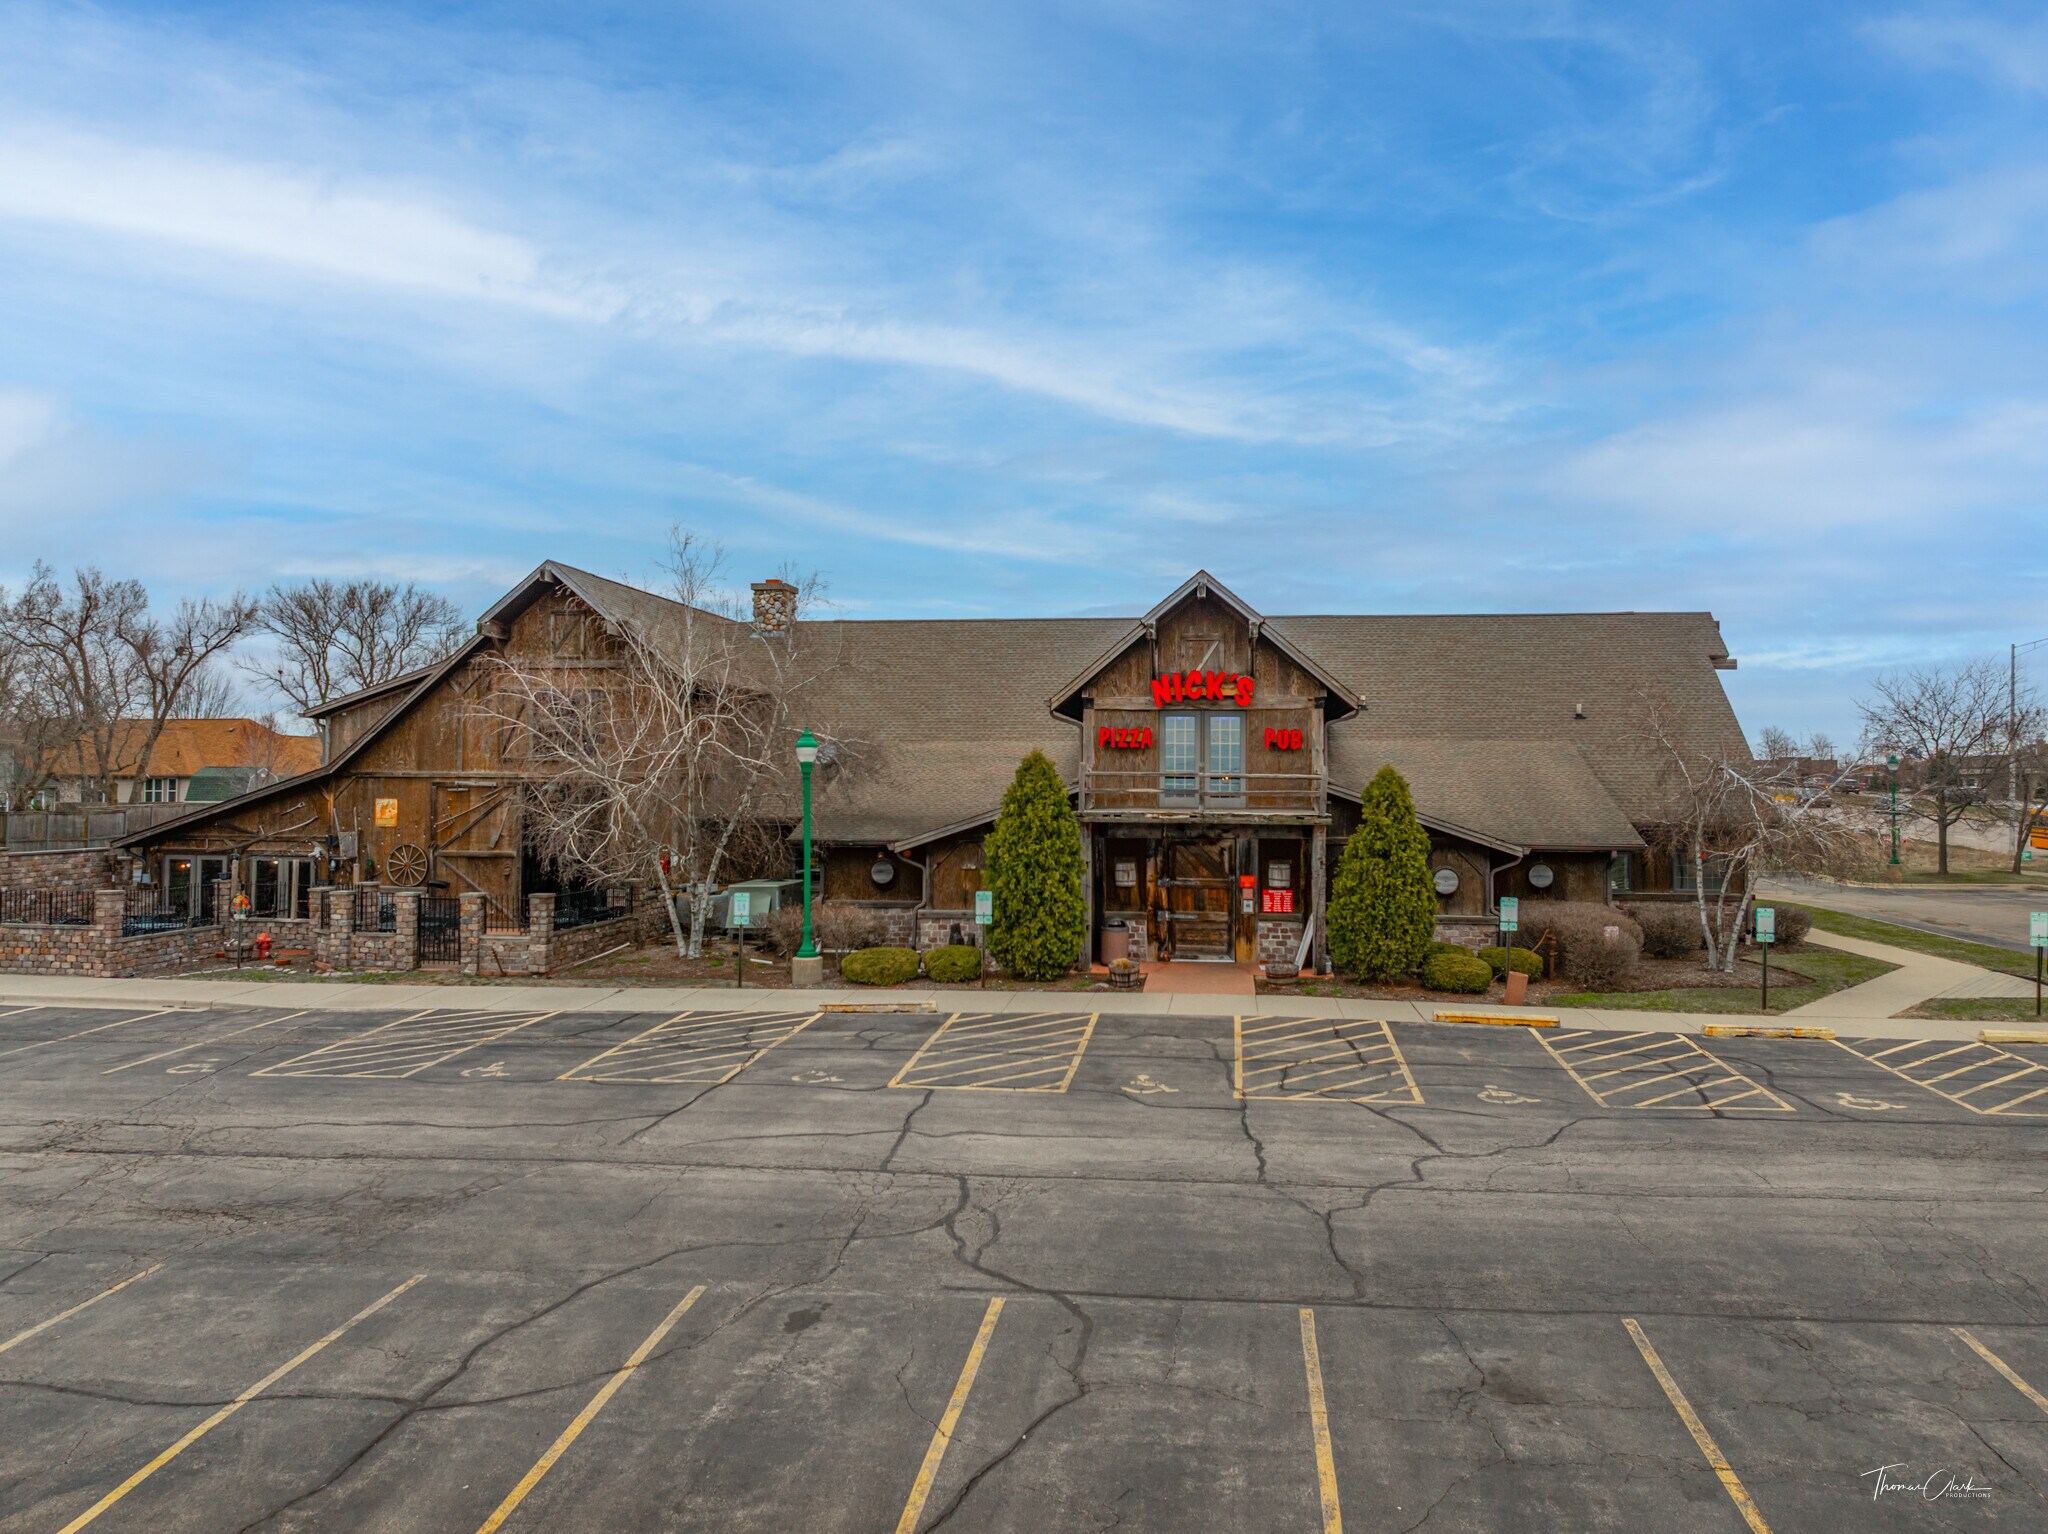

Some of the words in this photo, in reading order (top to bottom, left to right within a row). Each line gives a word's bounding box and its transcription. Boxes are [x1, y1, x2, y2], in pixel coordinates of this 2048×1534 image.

[1151, 669, 1254, 708] NICK'S
[1099, 726, 1152, 748] PIZZA
[1264, 727, 1303, 749] PUB
